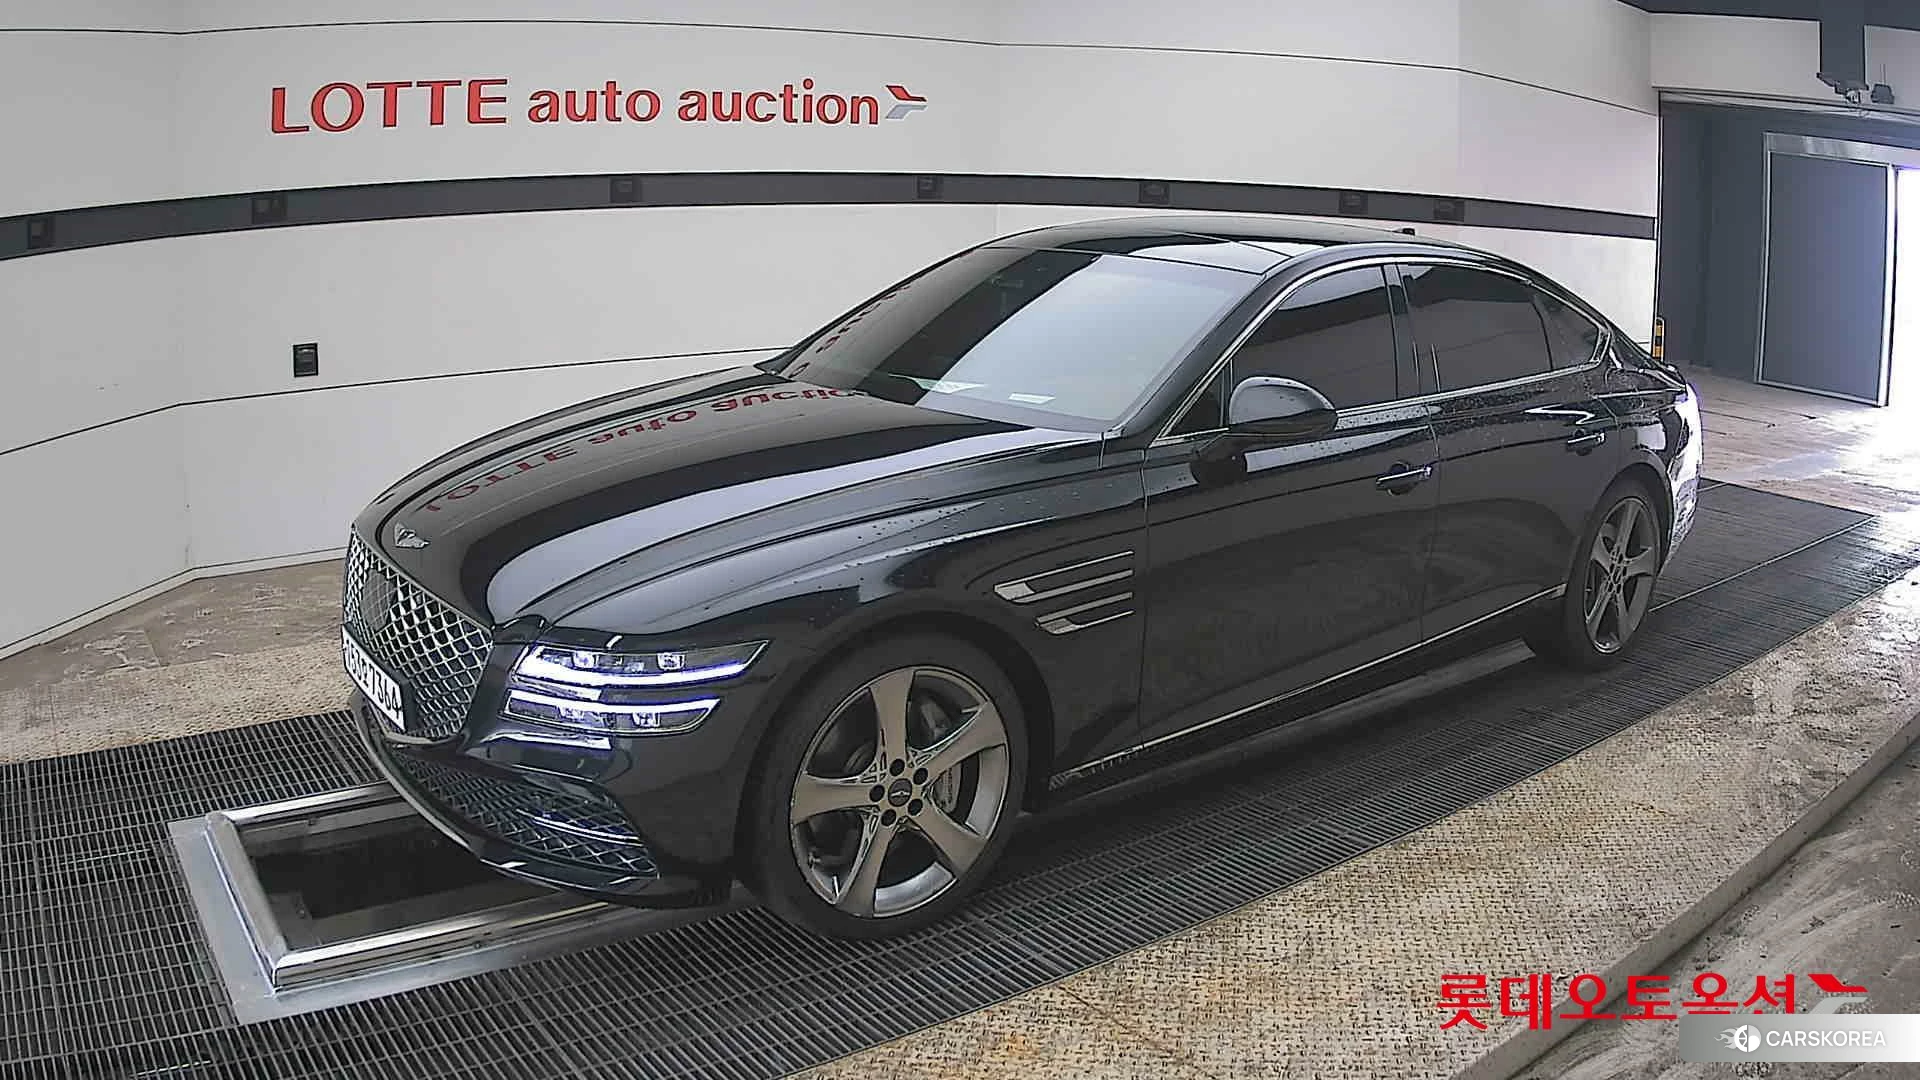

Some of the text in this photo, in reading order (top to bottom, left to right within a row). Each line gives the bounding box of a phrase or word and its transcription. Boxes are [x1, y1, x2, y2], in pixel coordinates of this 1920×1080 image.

[270, 78, 880, 135] LOTTE auto auction
